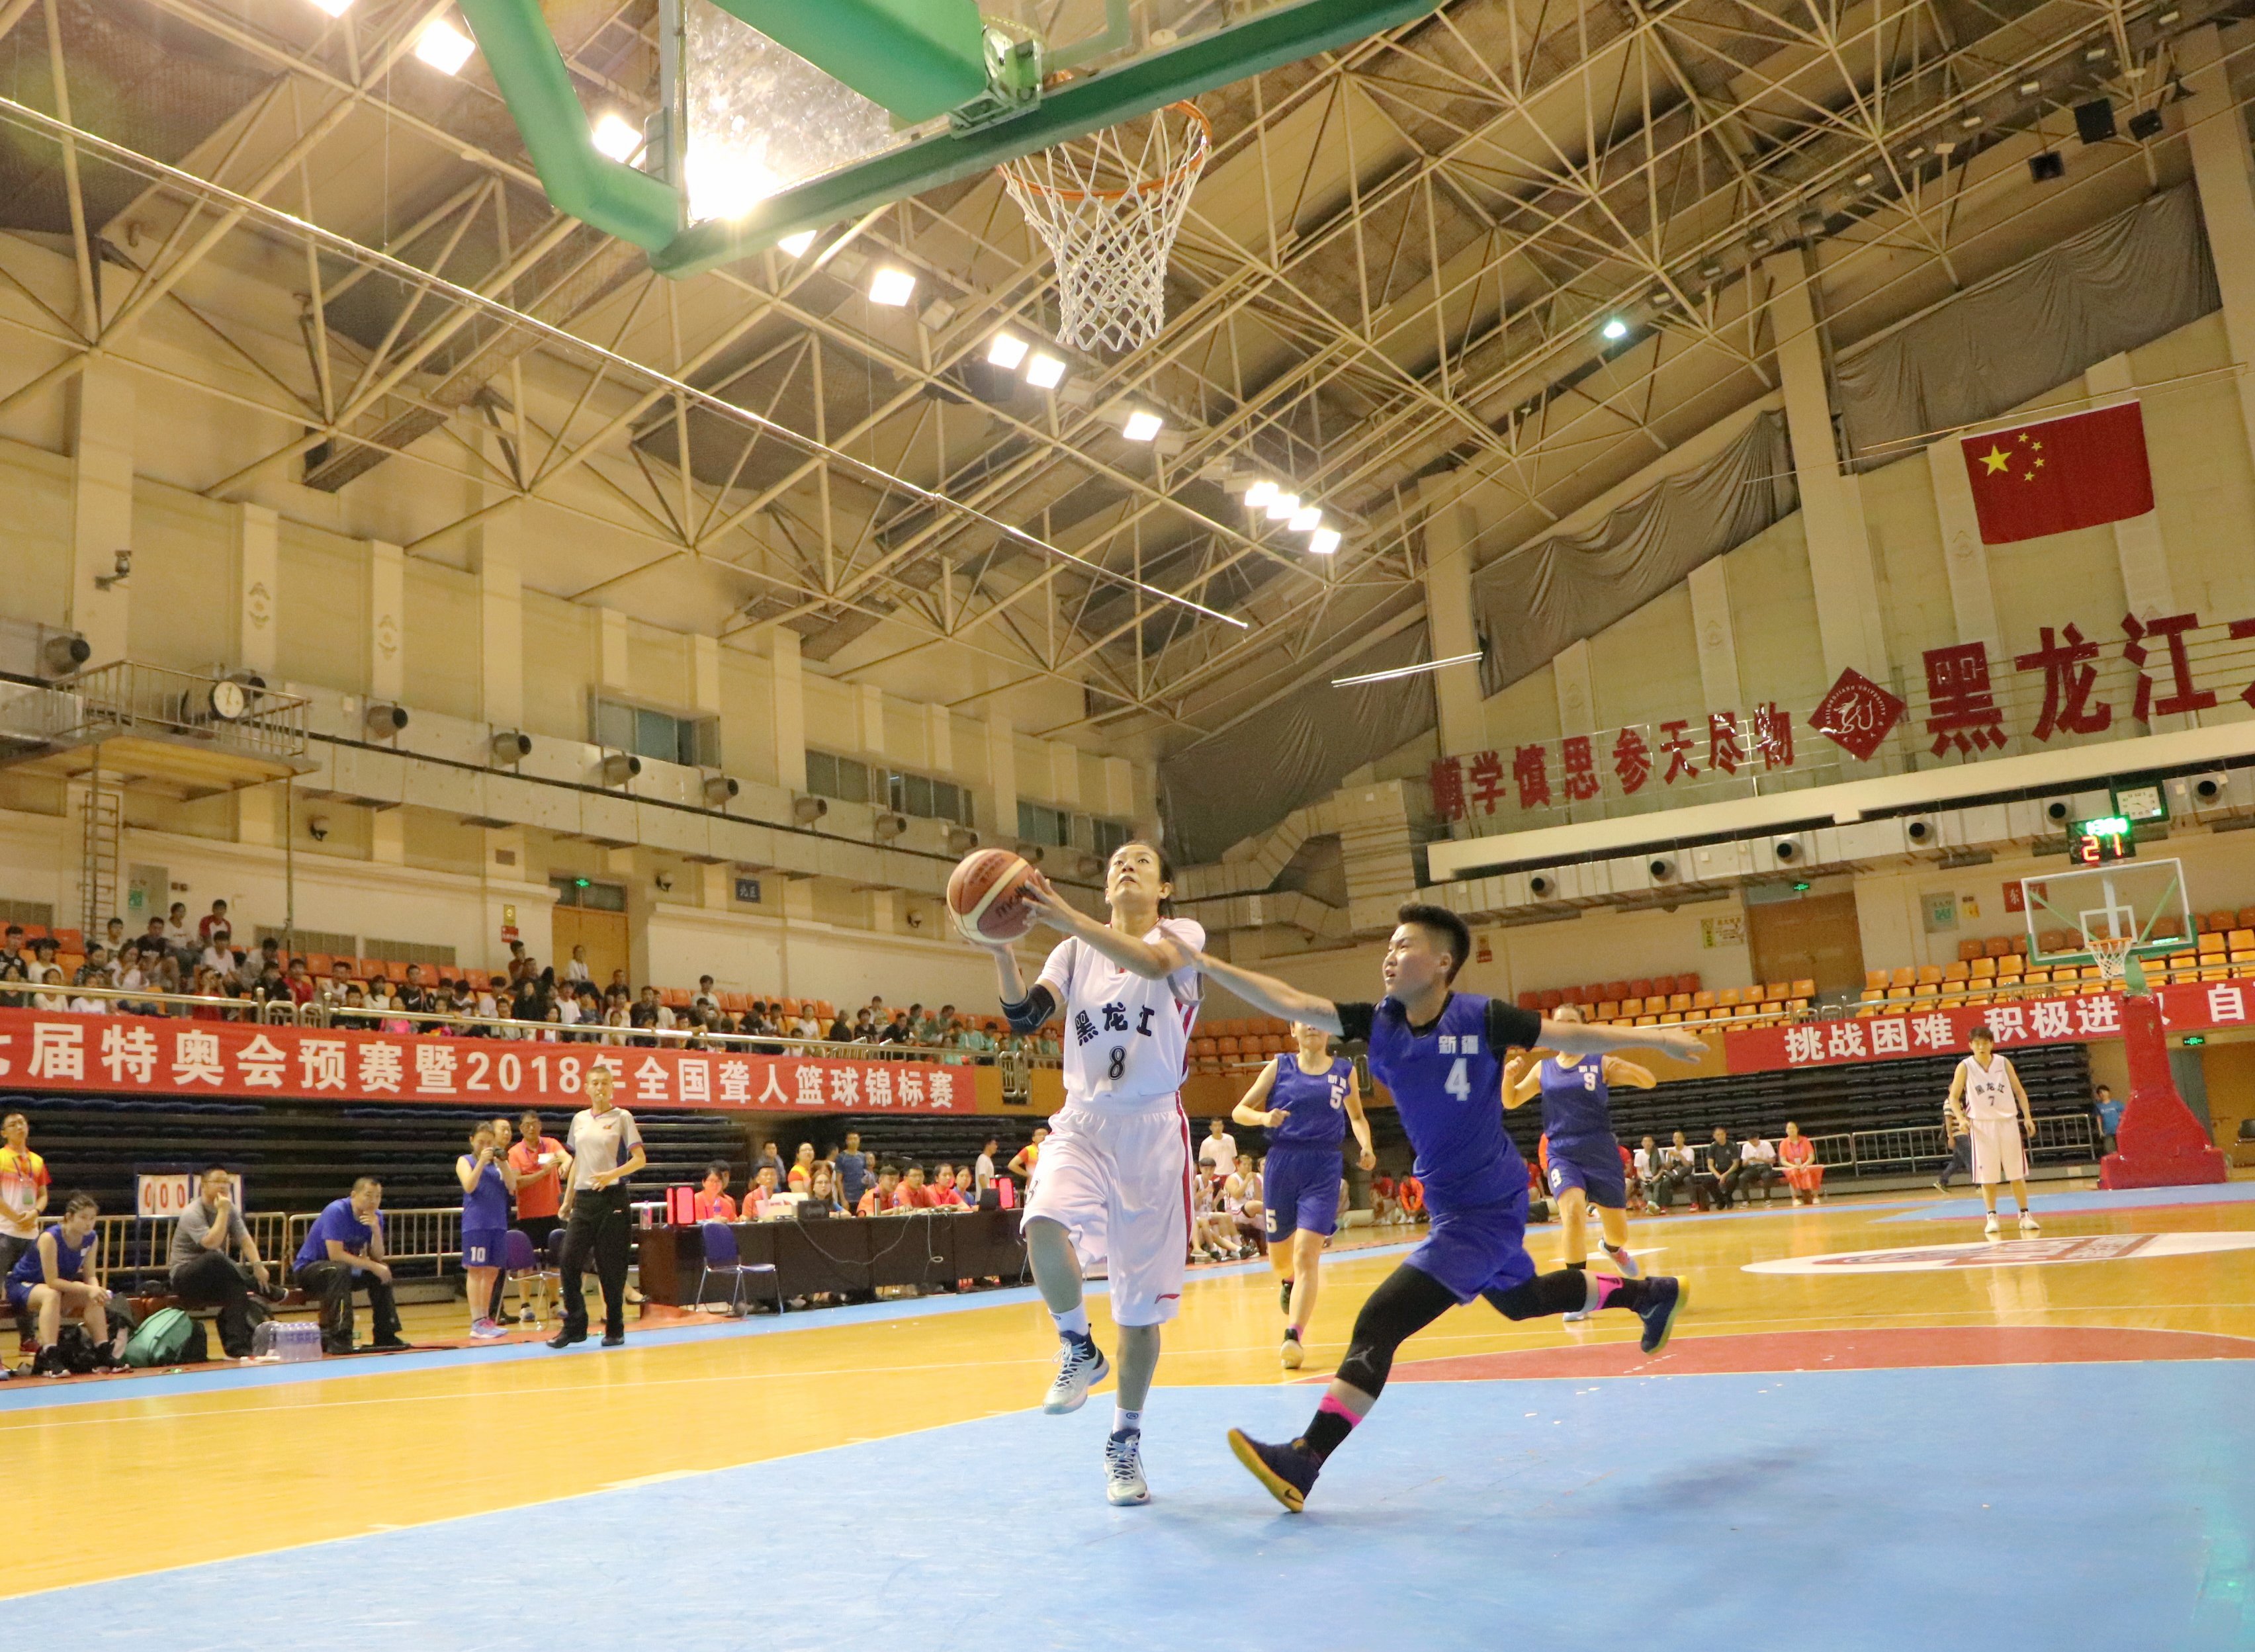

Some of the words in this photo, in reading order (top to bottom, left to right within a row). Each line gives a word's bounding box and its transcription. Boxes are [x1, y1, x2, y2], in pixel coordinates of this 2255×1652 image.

[1075, 1001, 1155, 1047] 黑龙江
[1785, 1015, 1955, 1064] 挑战困难
[2207, 981, 2255, 1022] 自
[0, 1022, 953, 1109] 届特奥会预赛暨2018年全国聋人篮球锦标赛
[1108, 1045, 1127, 1080] 8
[1444, 1057, 1472, 1102] 4
[1583, 1072, 1596, 1092] 9
[1329, 1085, 1344, 1109] 5
[1988, 1096, 1995, 1106] 7
[1265, 1209, 1278, 1234] 5
[470, 1246, 486, 1263] 10
